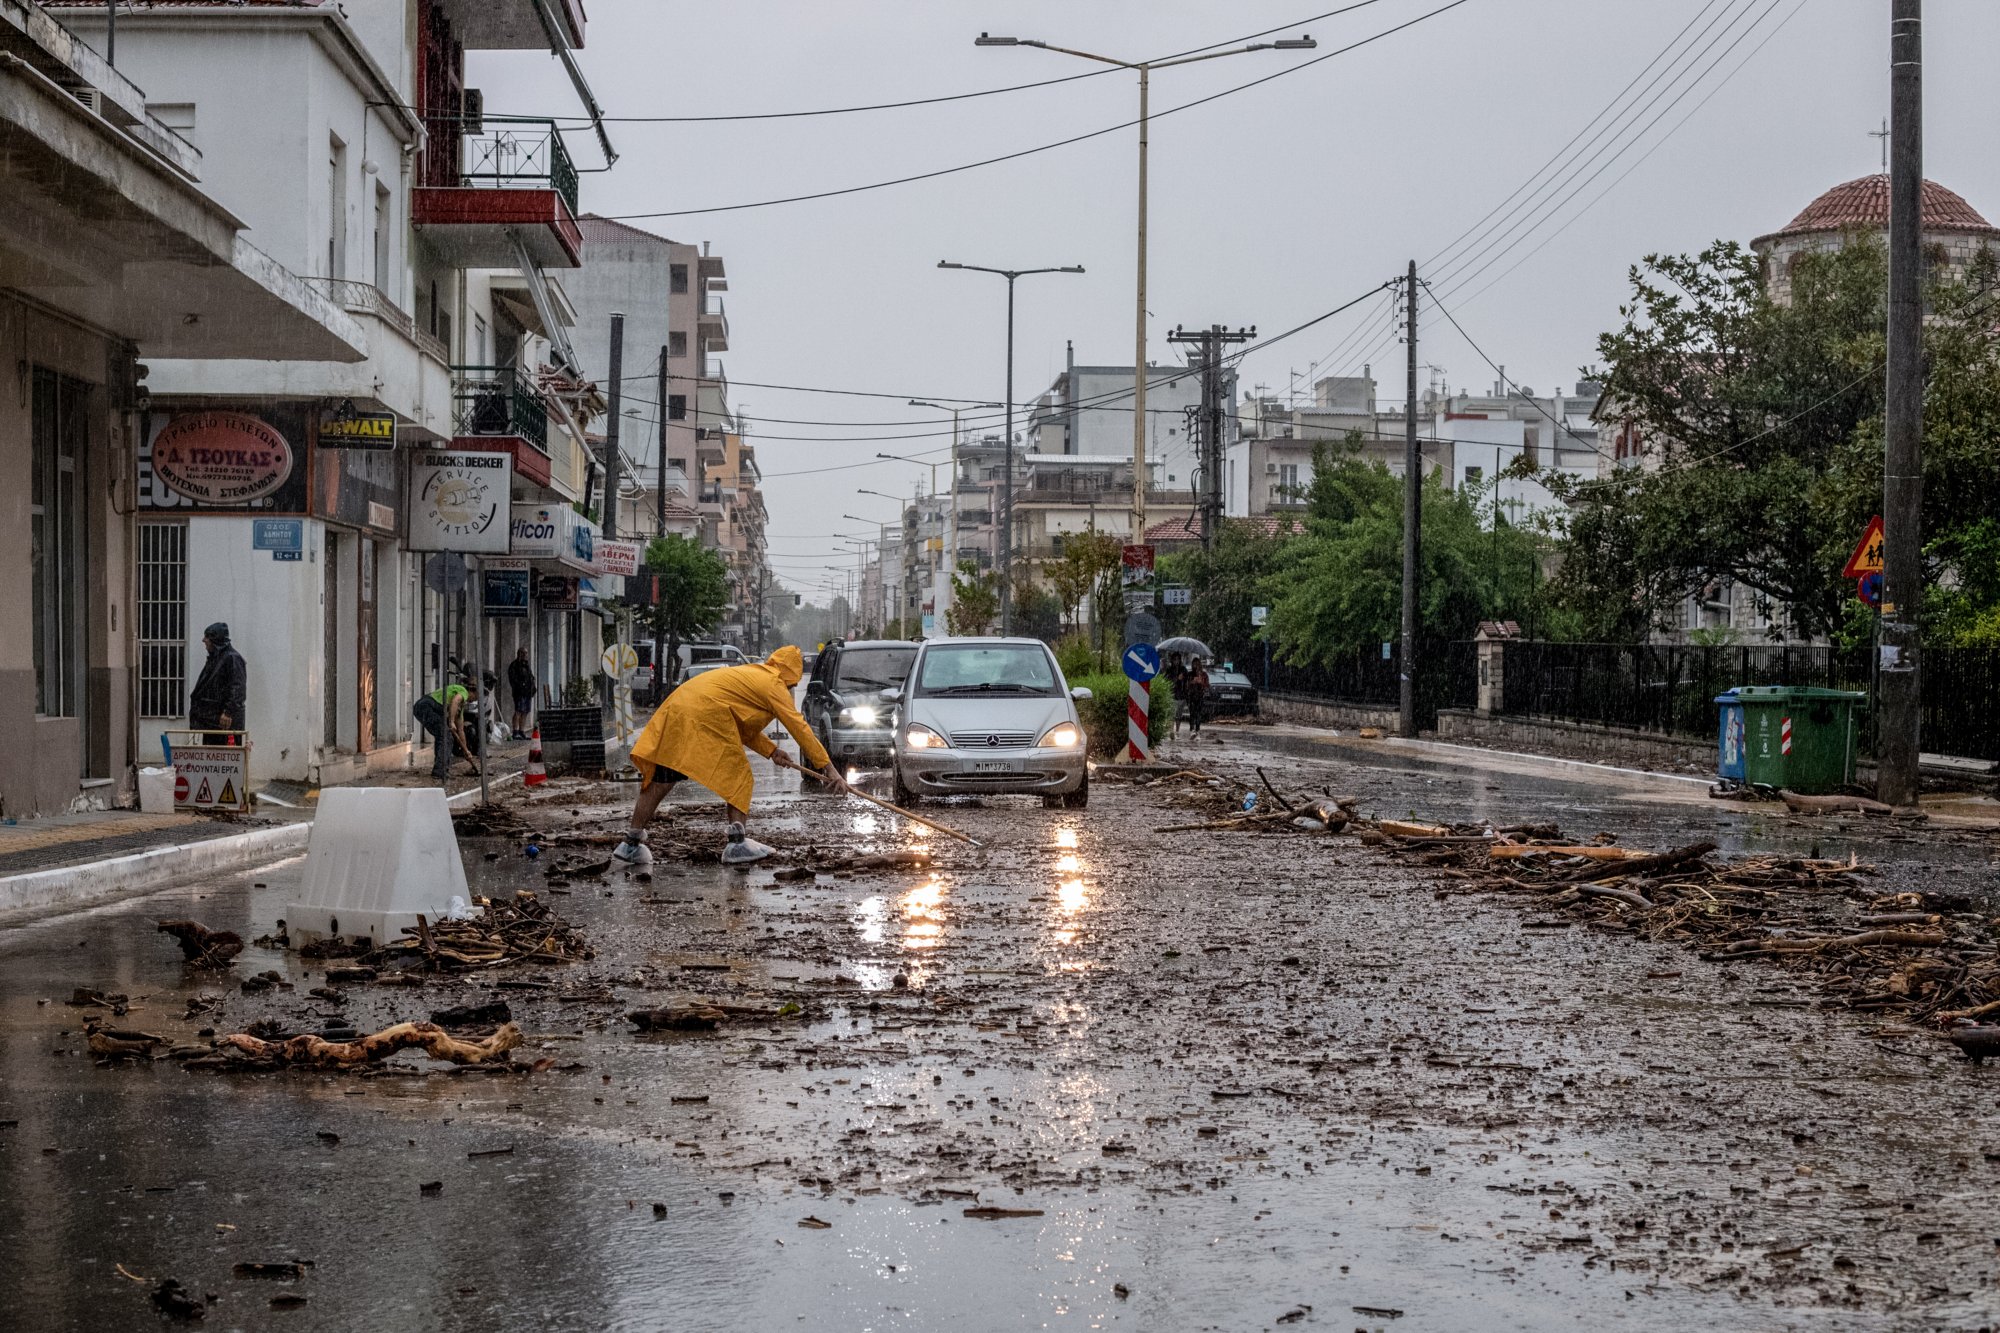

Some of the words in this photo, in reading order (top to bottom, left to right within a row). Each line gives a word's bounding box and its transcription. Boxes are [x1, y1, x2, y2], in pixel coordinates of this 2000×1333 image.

[164, 419, 217, 445] ΓΡΑΦΕΙΟ
[225, 419, 278, 449] ΤΕΛΕΤΩΝ
[189, 448, 272, 467] ΤΣΟΥΚΑΣ
[160, 464, 210, 497] ΒΙΟΤΕΧΝΙΑ
[219, 469, 278, 497] ΣΤΕΦΑΝΙΩΝ
[430, 468, 488, 492] SERVICE
[429, 510, 488, 536] STATION
[174, 752, 204, 760] ΔΡΟΜΟΣ
[206, 752, 240, 762] ΚΛΕΙΣΤΟΣ
[222, 766, 239, 774] ΕΡΓΑ
